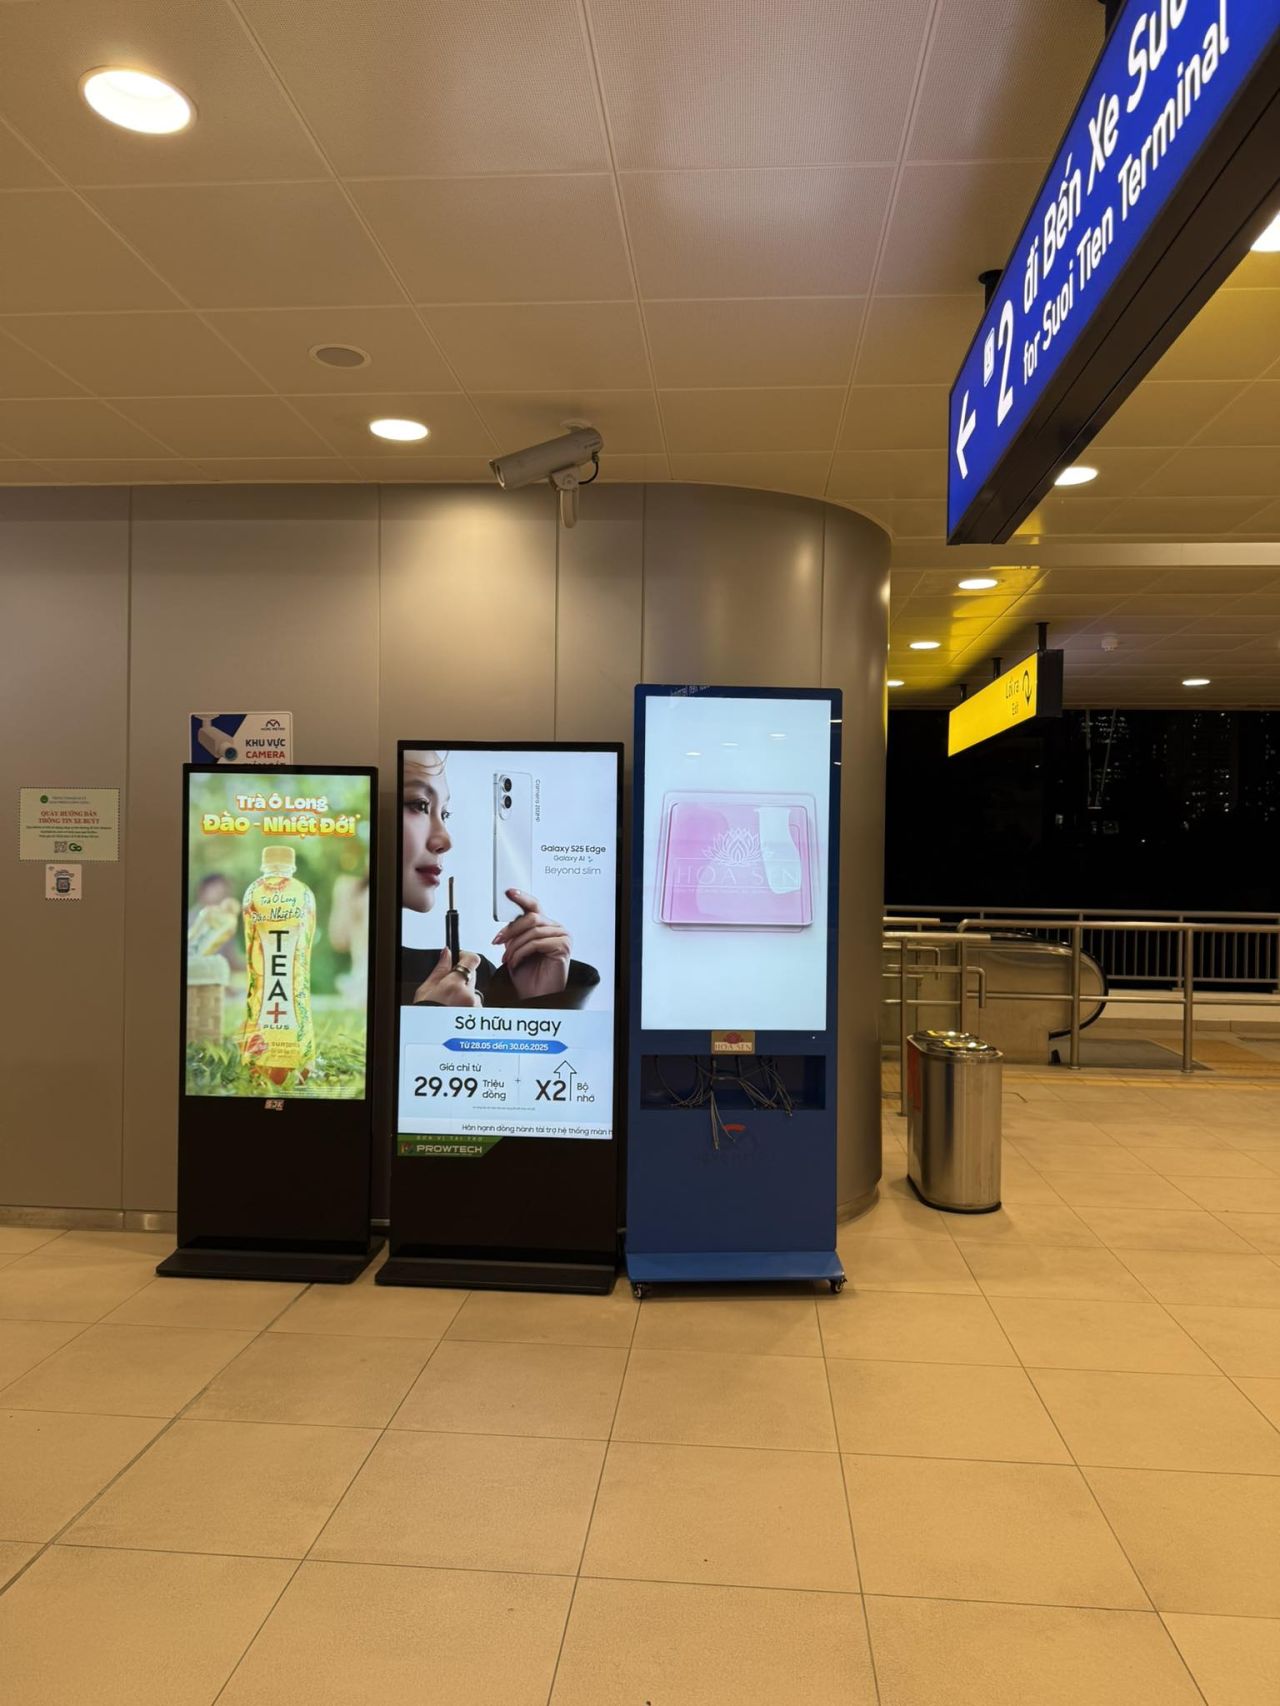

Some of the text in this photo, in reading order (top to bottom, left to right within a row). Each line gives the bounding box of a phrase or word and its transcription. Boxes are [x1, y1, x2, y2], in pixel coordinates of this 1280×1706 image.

[1024, 0, 1230, 385] for Suoi Tien Terminal
[1023, 235, 1039, 314] đi
[1043, 152, 1081, 279] Bến
[1088, 93, 1119, 196] Xe
[998, 300, 1014, 427] 2
[245, 738, 286, 749] KHU VỰC
[246, 751, 285, 759] CAMERA
[236, 793, 328, 812] Trà Ô Long
[202, 811, 250, 834] Đào
[262, 815, 318, 839] Nhiệt
[319, 815, 356, 836] Đới
[541, 844, 606, 855] Galaxy S25 Edge
[553, 855, 578, 863] Galaxy
[544, 866, 602, 876] Beyond slim
[677, 865, 737, 885] HOA
[454, 1014, 562, 1036] Sở hữu ngay
[459, 1041, 549, 1051] Từ 28.05 đến 30.06.2025
[439, 1063, 482, 1072] Giá chỉ từ
[414, 1075, 504, 1098] 29.99 Triệu
[535, 1079, 589, 1101] X2 Bộ
[482, 1089, 506, 1101] đồng
[577, 1093, 595, 1103] nhớ
[416, 1144, 482, 1153] PROWTECH
